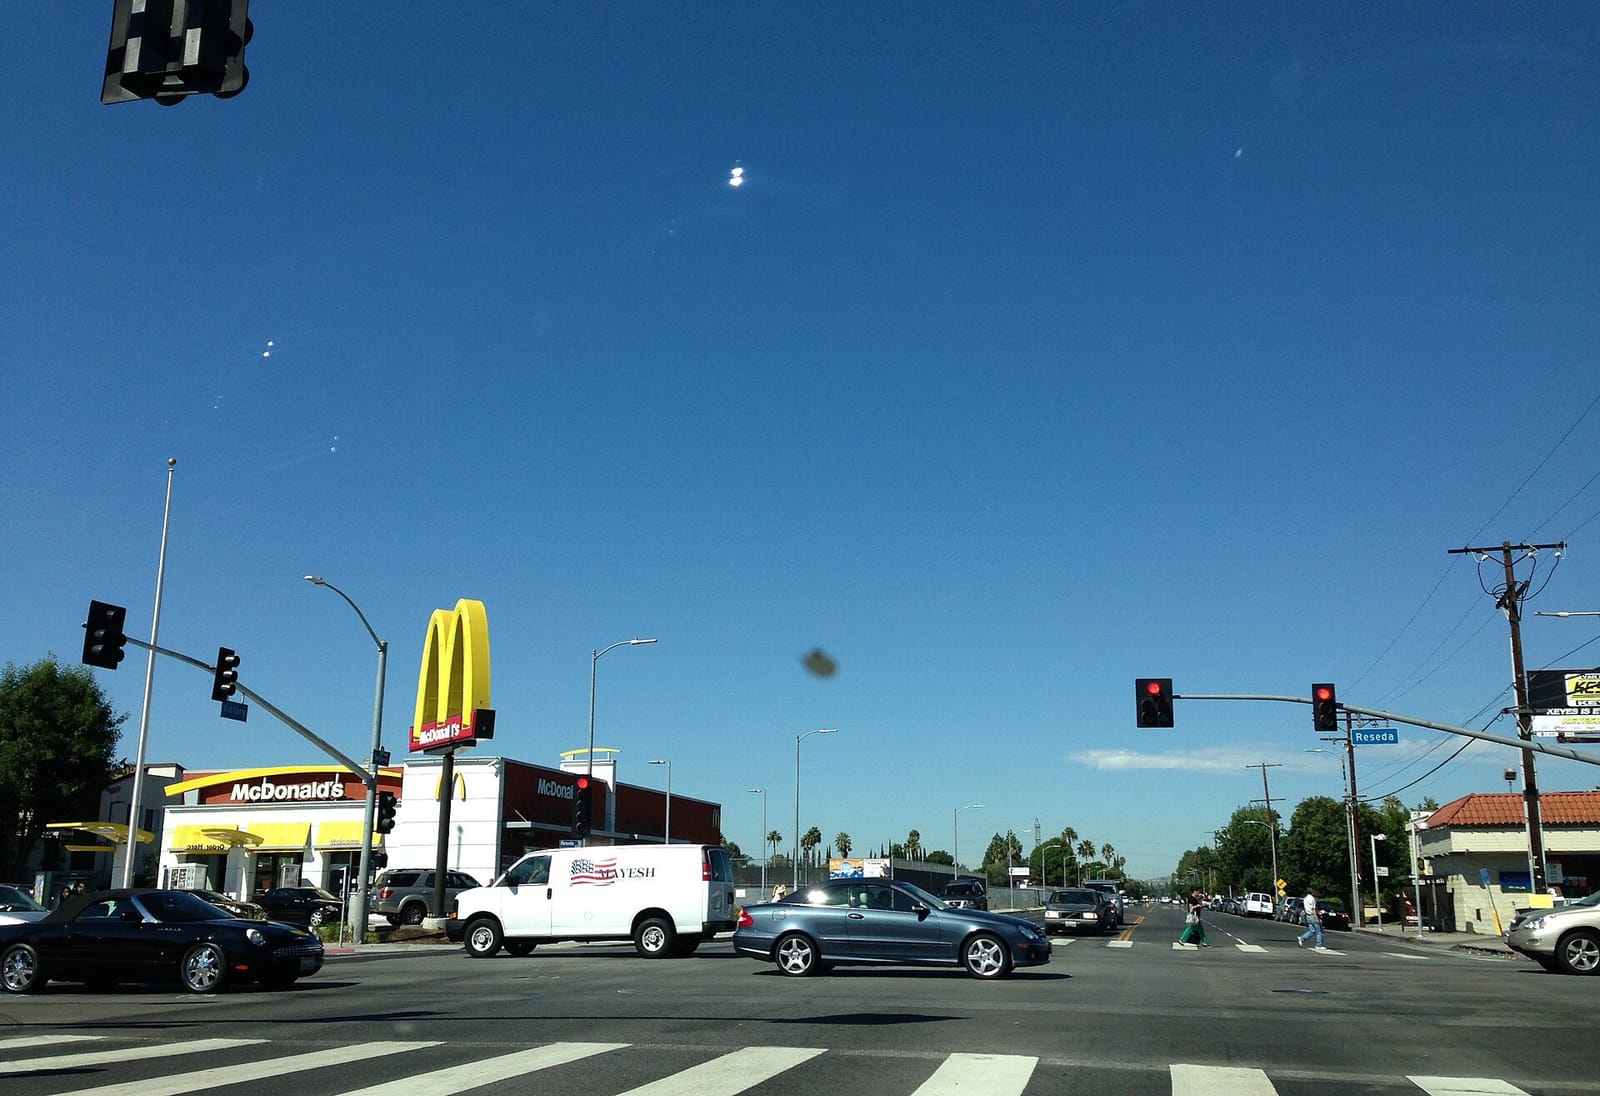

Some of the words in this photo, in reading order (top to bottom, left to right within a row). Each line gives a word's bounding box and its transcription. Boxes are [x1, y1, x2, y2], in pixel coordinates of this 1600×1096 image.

[1355, 733, 1394, 741] Reseda
[230, 782, 344, 801] McDonald's
[600, 867, 656, 879] MAYESH
